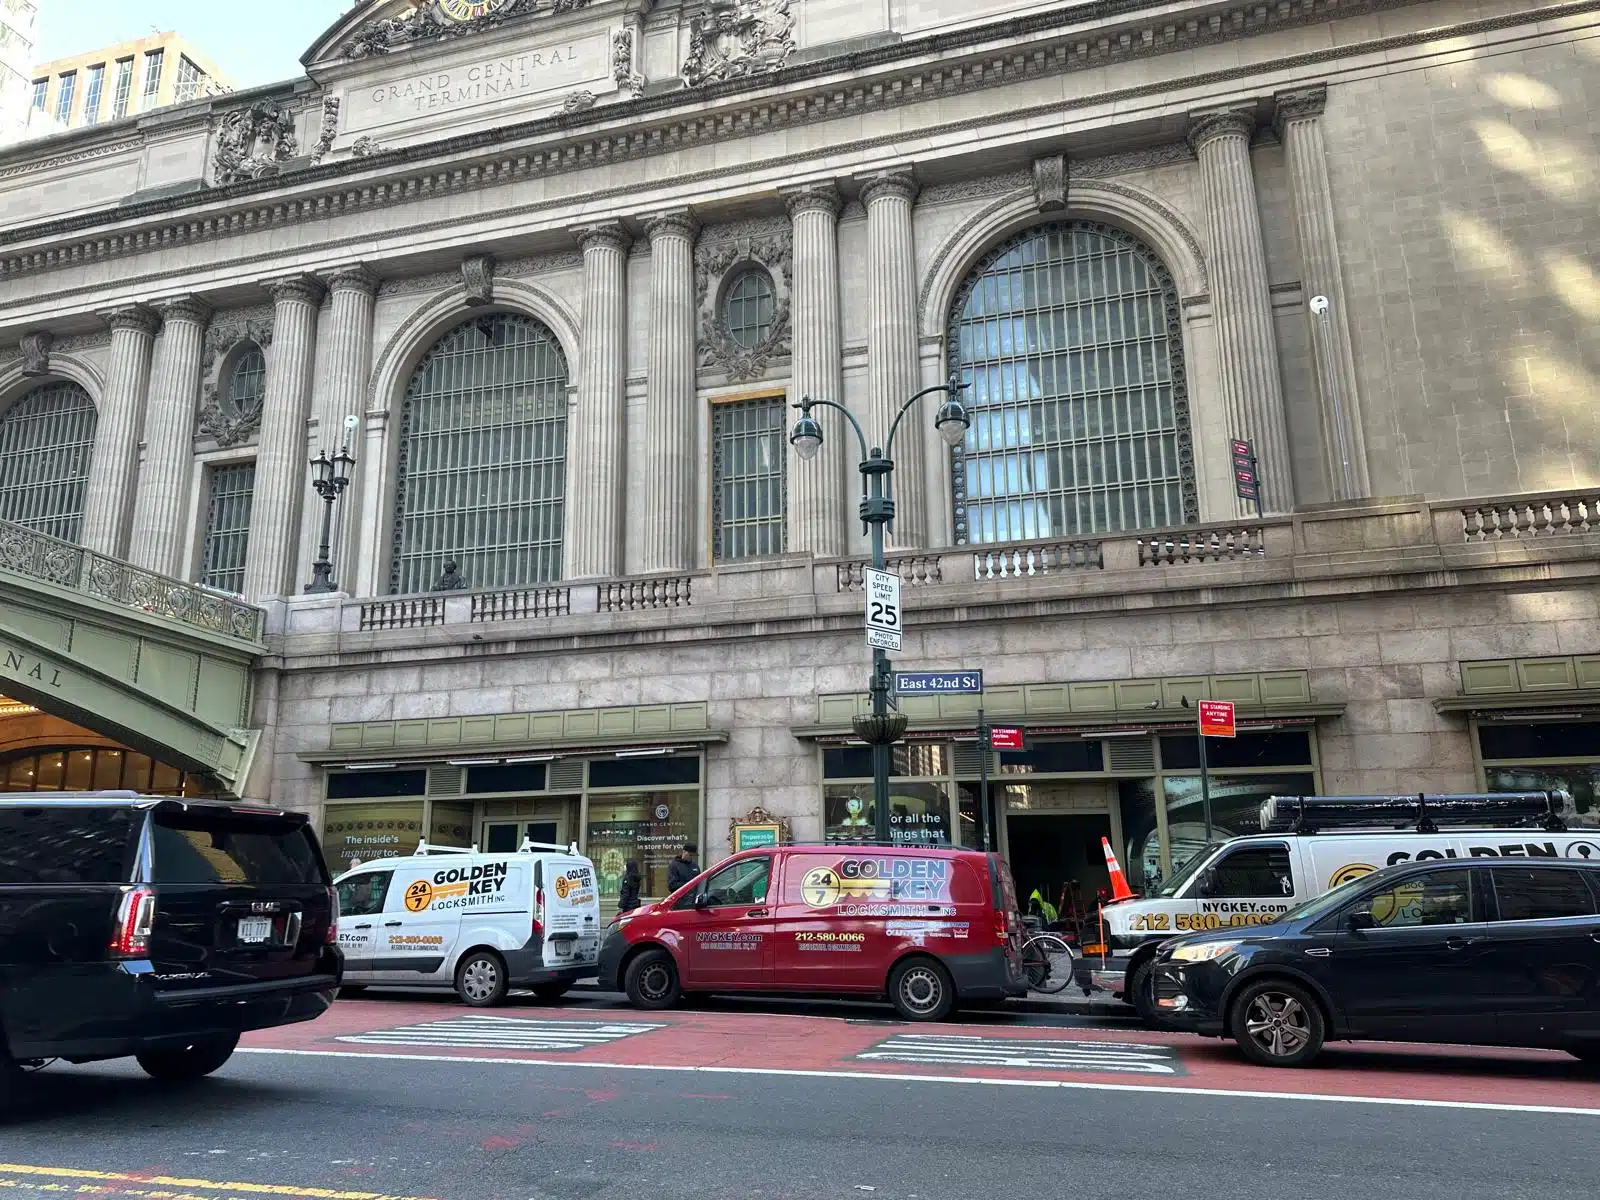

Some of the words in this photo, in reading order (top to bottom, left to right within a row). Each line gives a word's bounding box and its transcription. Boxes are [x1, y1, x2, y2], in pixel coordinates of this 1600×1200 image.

[371, 74, 450, 103] GRAND
[467, 46, 577, 82] CENTRAL
[414, 74, 530, 111] TERMINAL
[875, 574, 890, 583] CITY
[872, 582, 893, 593] SPEED
[874, 591, 892, 601] LIMIT
[871, 602, 897, 626] 25
[875, 632, 894, 640] PHOTO
[869, 637, 899, 648] ENFORCED
[3, 649, 62, 688] NAL
[900, 678, 927, 689] East
[929, 677, 959, 689] 42nd
[962, 676, 977, 688] St
[1206, 710, 1228, 718] ANYTIME
[889, 814, 903, 824] or
[905, 813, 919, 823] all
[921, 813, 941, 823] the
[345, 836, 362, 844] The
[364, 835, 399, 844] inside's
[666, 834, 688, 842] what's
[920, 829, 945, 839] that
[340, 847, 382, 859] inspiring
[433, 861, 508, 885] GOLDEN
[566, 867, 591, 880] GOLDEN
[841, 859, 946, 879] GOLDEN
[581, 877, 592, 888] KEY
[810, 873, 832, 886] 24
[411, 883, 427, 896] 24
[468, 877, 506, 895] KEY
[892, 879, 945, 900] KEY
[414, 897, 422, 909] 7
[431, 894, 494, 911] LOCKSMITH
[494, 895, 505, 903] INC
[815, 890, 826, 904] 7
[837, 904, 926, 917] LOCKSMITH
[941, 907, 957, 916] INC
[1202, 902, 1288, 913] NYGKEY.com
[1128, 913, 1170, 931] 212
[695, 931, 763, 942] NYGKEY.com
[794, 932, 865, 942] 212-580-0066
